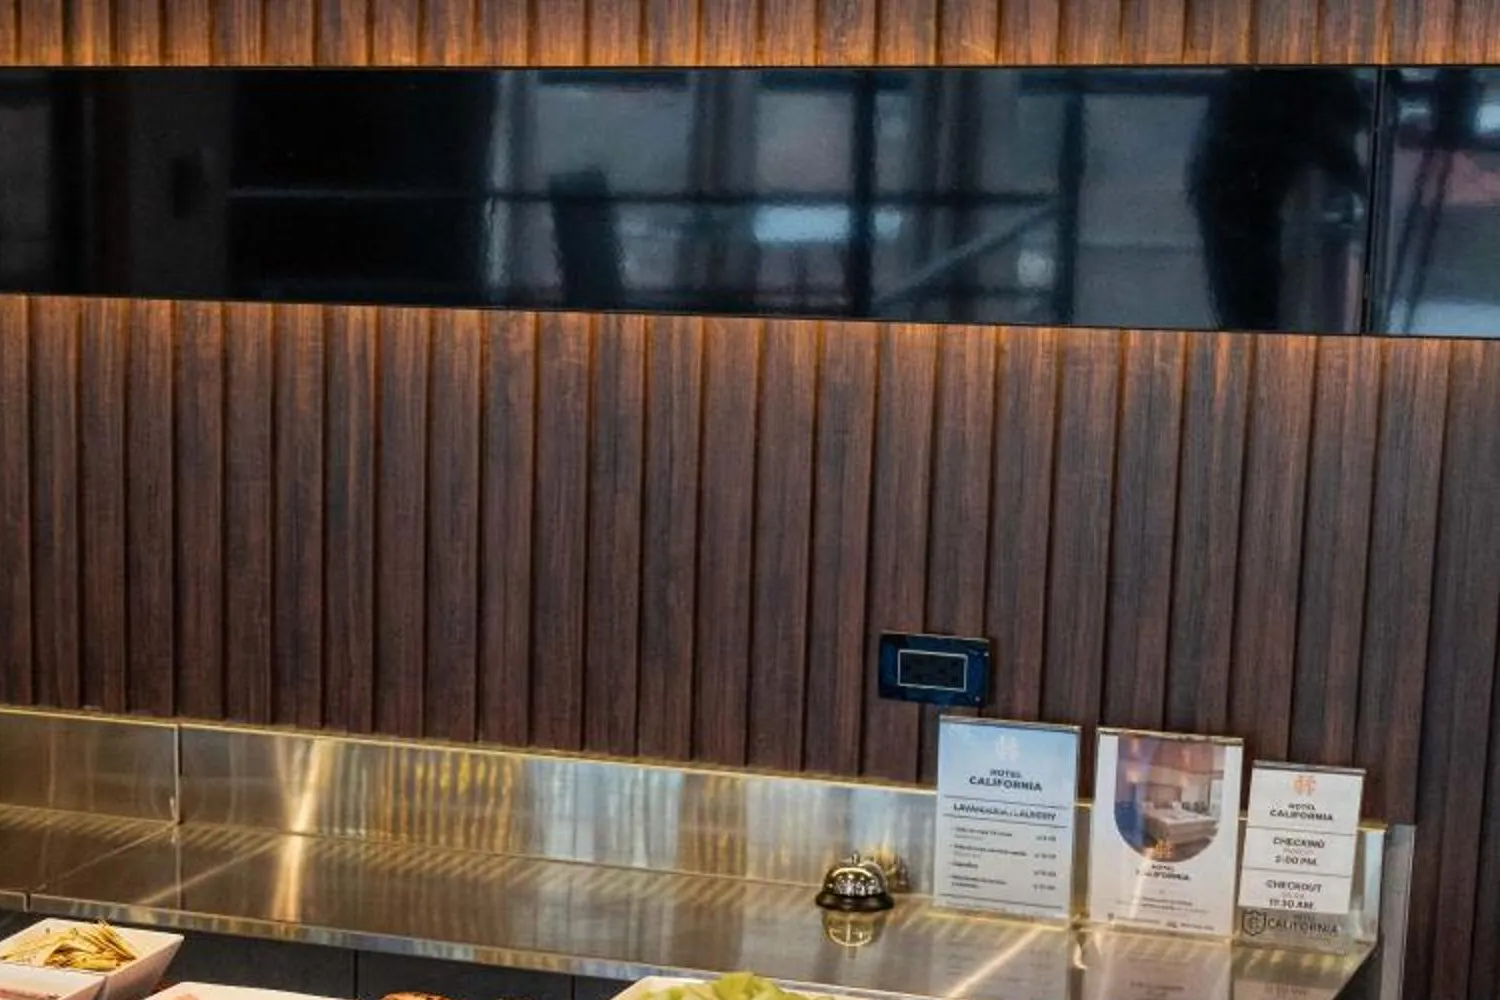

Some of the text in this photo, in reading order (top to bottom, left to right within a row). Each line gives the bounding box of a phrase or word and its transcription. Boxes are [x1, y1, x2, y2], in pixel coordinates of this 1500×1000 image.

[990, 769, 1021, 778] HOTEL
[969, 776, 1043, 791] CALIFORNIA
[1269, 809, 1333, 821] CALIFORNIA
[1266, 880, 1322, 893] CHECKOUT
[1268, 918, 1338, 933] CALIFORNIA
